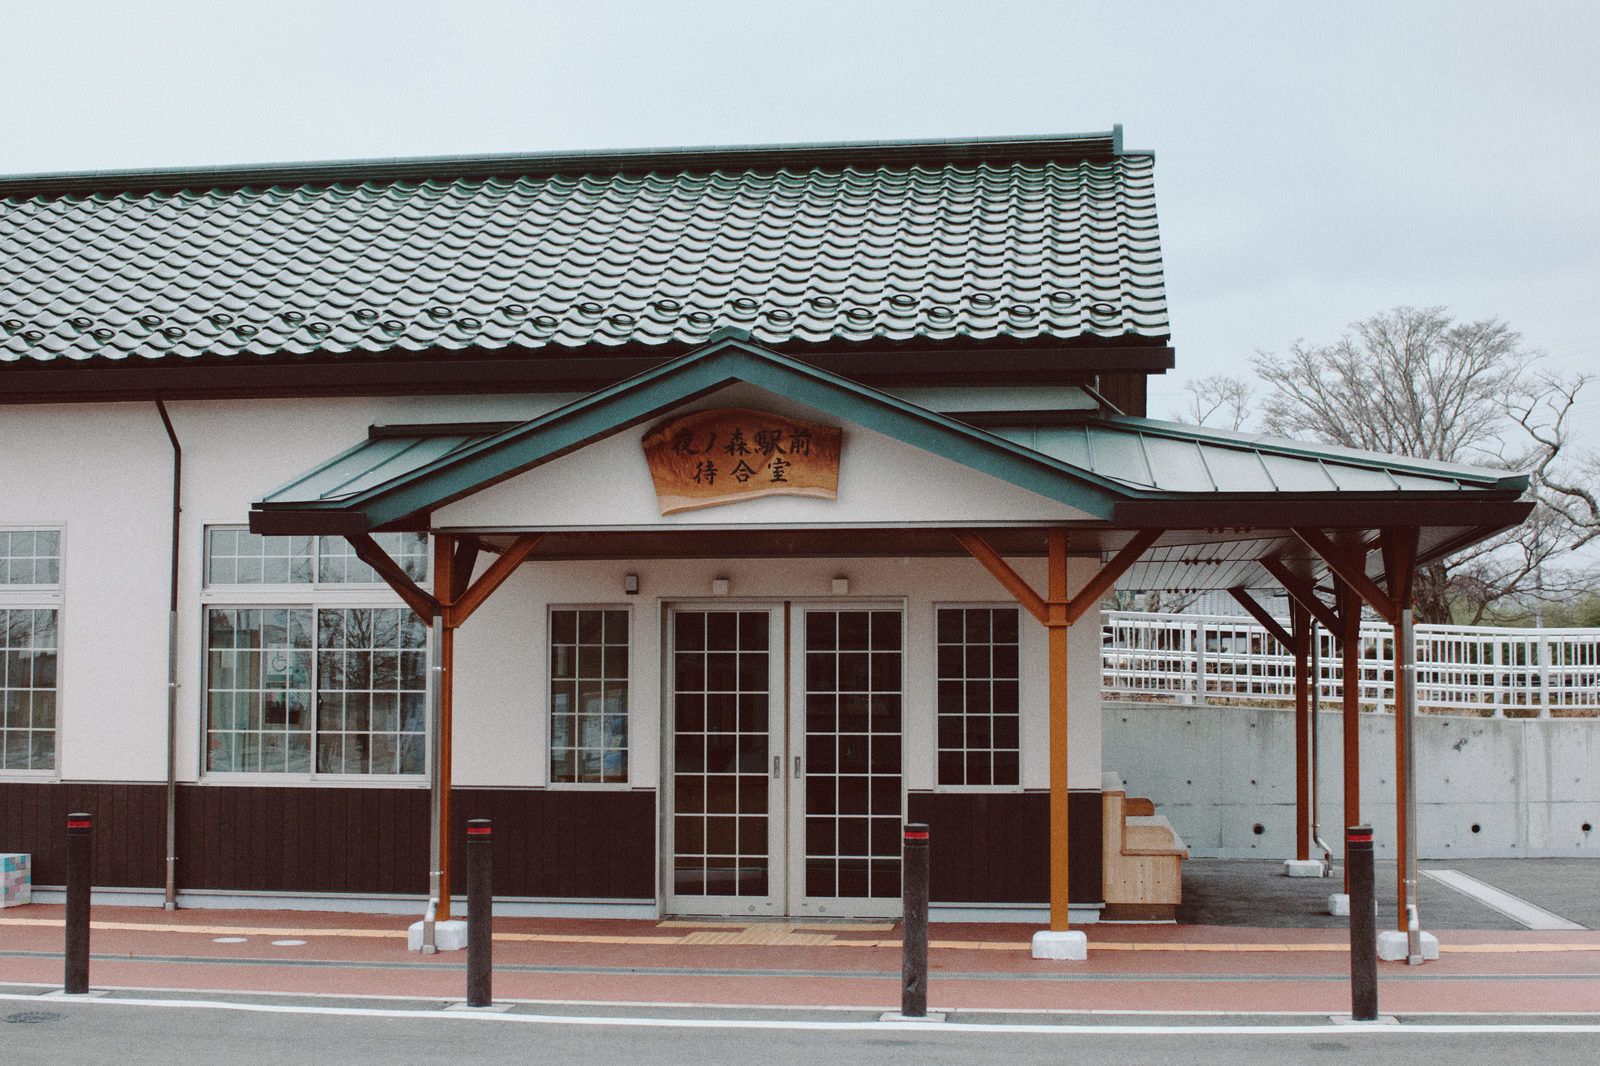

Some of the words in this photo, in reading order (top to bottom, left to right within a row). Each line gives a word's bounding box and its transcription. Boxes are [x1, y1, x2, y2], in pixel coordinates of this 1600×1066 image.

[673, 429, 811, 456] 夜ノ森駅前
[693, 458, 791, 485] 待合室
